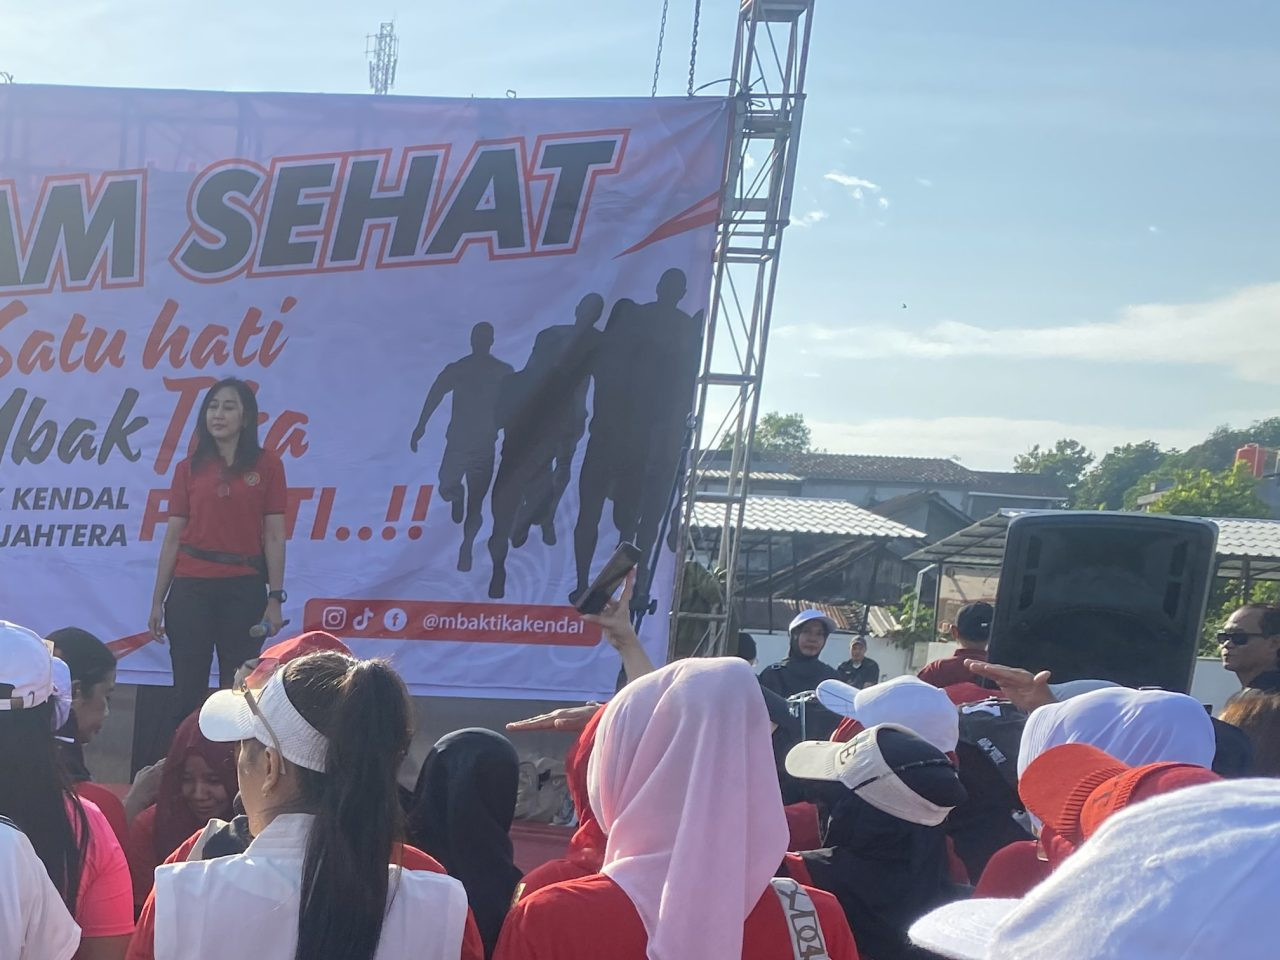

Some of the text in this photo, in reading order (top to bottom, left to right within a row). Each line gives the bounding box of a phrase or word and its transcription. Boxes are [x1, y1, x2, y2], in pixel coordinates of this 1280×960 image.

[173, 132, 627, 281] SEHAT
[142, 296, 297, 370] hati
[153, 376, 310, 476] Ta
[12, 487, 130, 511] KENDAL
[138, 484, 434, 542] PTI..!!
